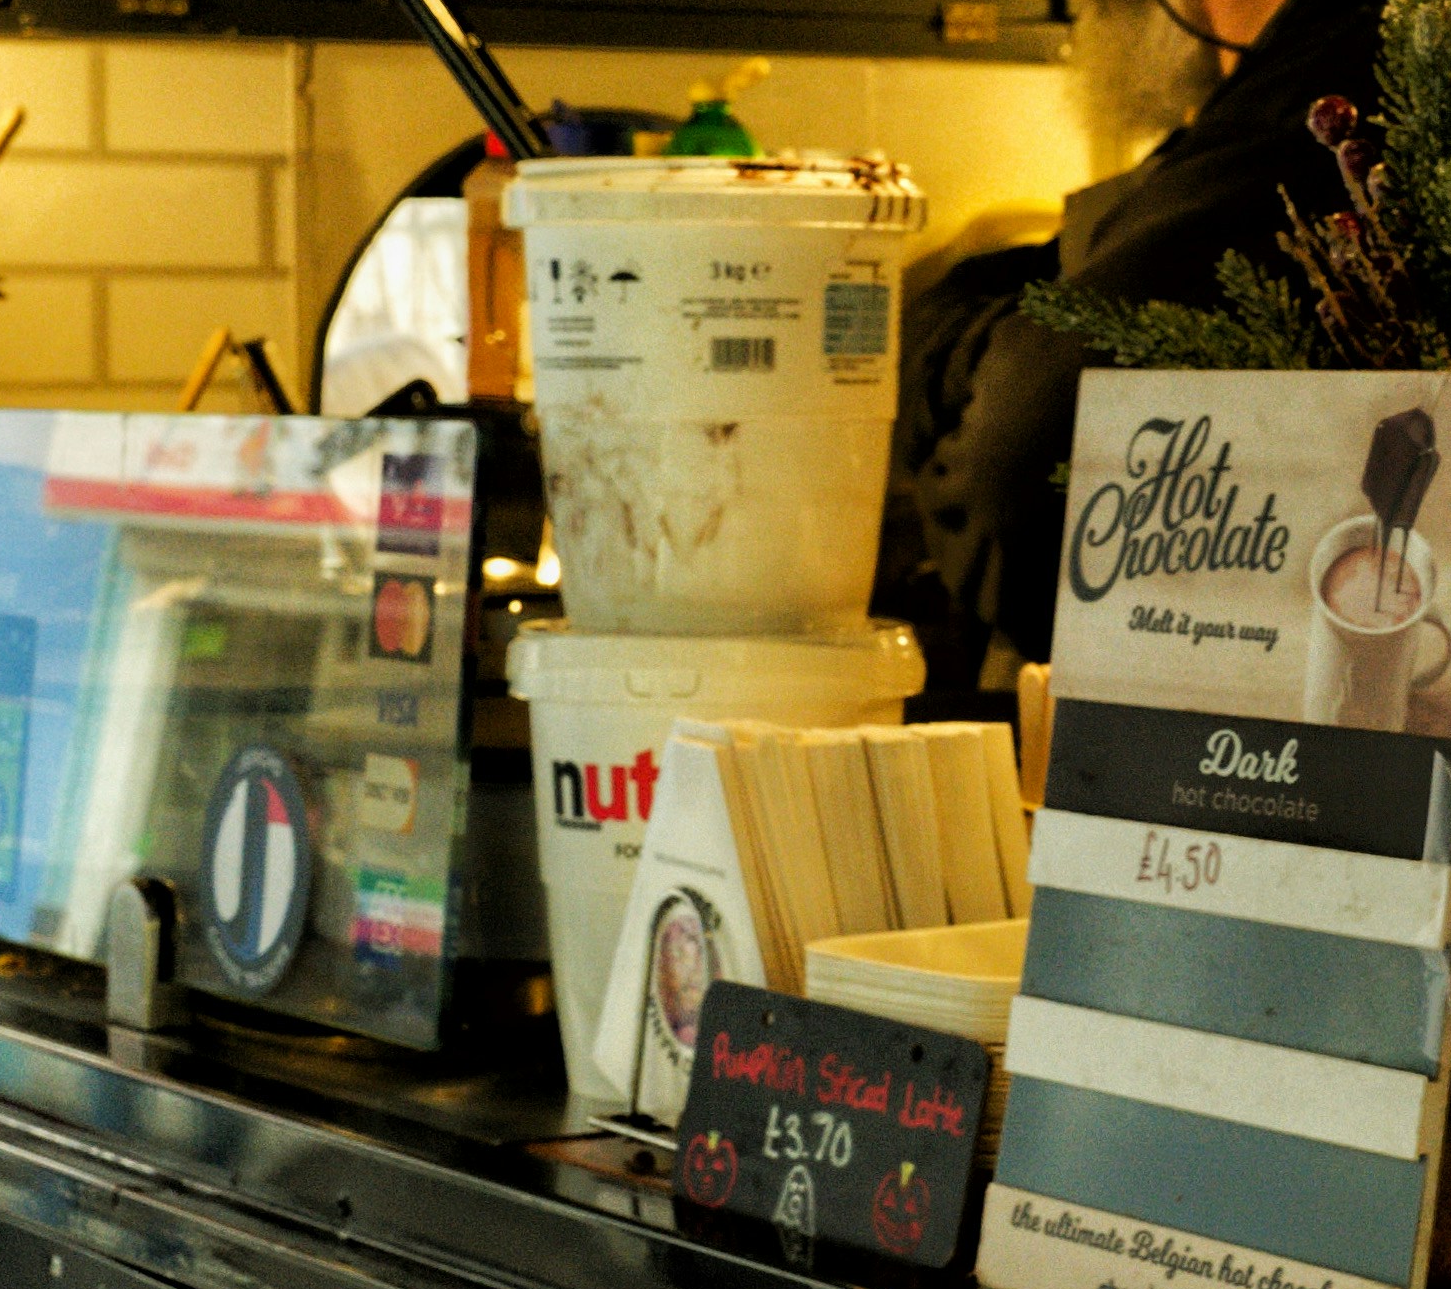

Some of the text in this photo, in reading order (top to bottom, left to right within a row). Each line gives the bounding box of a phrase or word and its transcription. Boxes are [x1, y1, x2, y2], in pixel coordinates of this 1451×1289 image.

[1126, 414, 1233, 531] Hot
[1069, 480, 1289, 603] Chocolate
[1128, 605, 1174, 635] Melt
[1192, 617, 1236, 647] your
[1238, 623, 1279, 653] way
[1199, 728, 1300, 785] Dark
[1172, 779, 1319, 823] hot chocolate
[1136, 829, 1222, 894] £4.50
[1010, 1199, 1042, 1233] the
[1043, 1211, 1127, 1257] ultimate
[1128, 1228, 1216, 1283] Belgian
